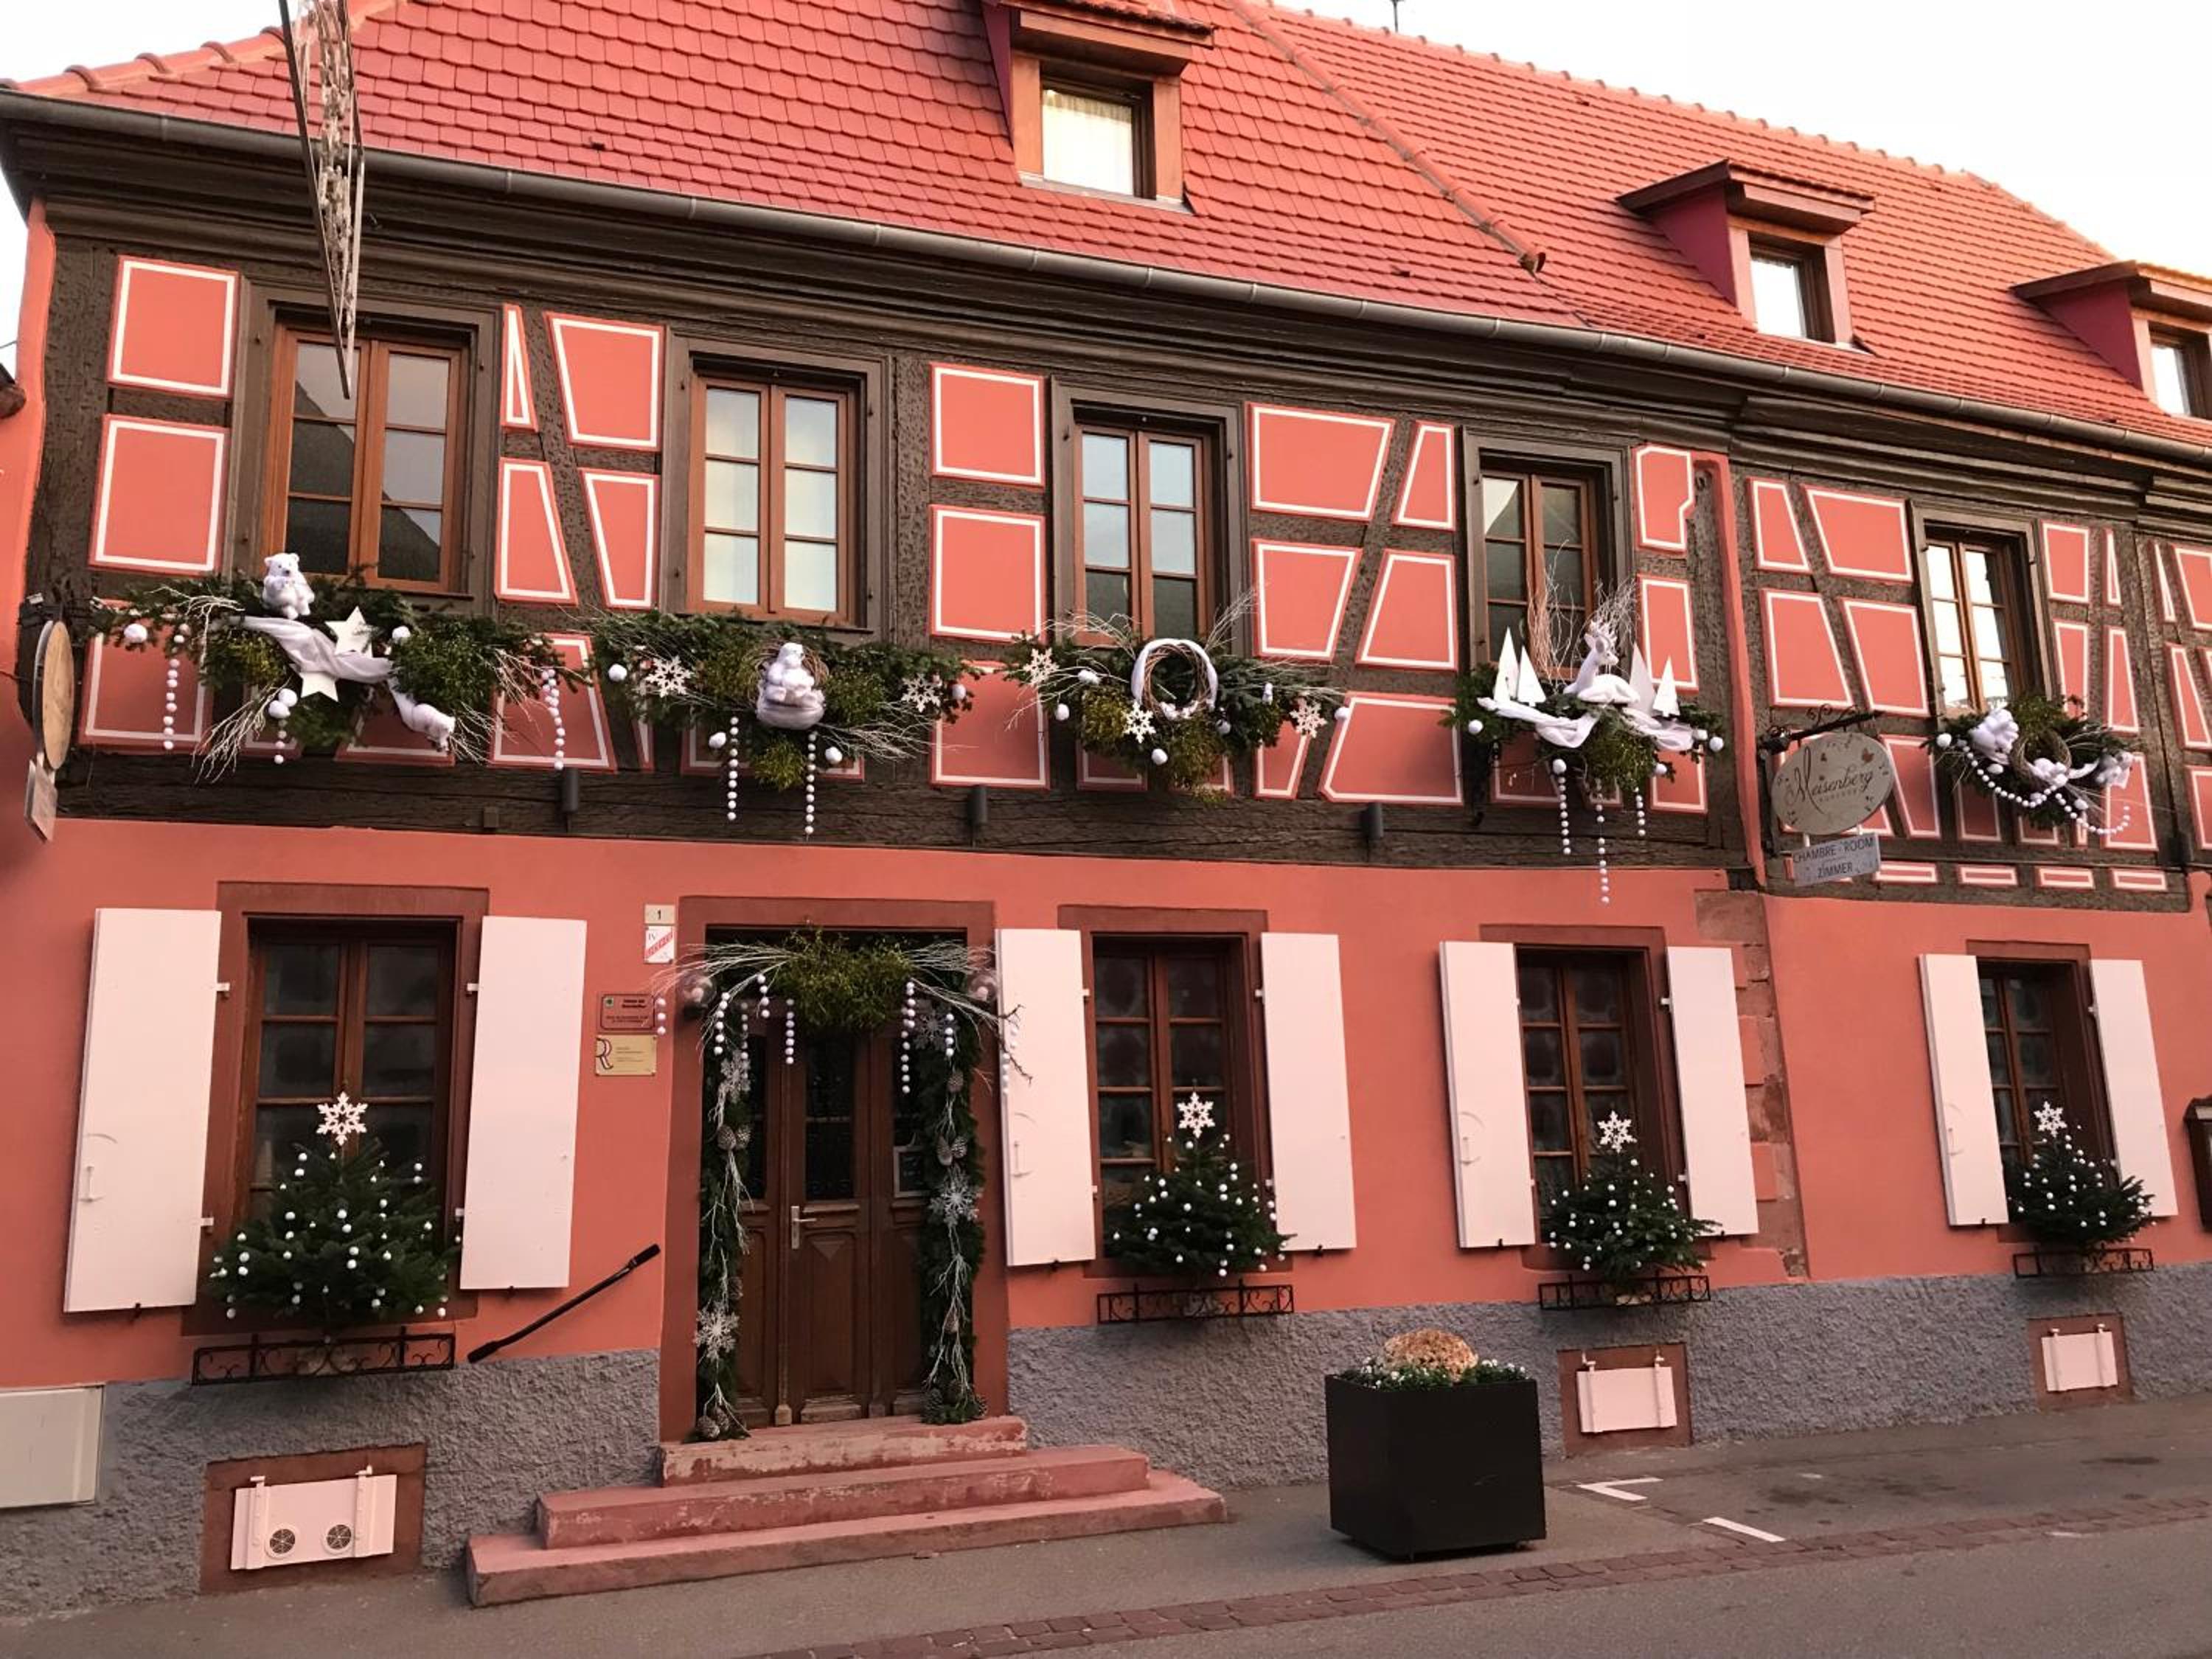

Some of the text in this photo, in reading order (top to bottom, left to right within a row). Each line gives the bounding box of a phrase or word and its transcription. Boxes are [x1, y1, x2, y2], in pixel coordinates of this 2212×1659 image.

[1794, 837, 1874, 863] CHAMBRE ROOM
[1818, 862, 1853, 878] ZIMMER
